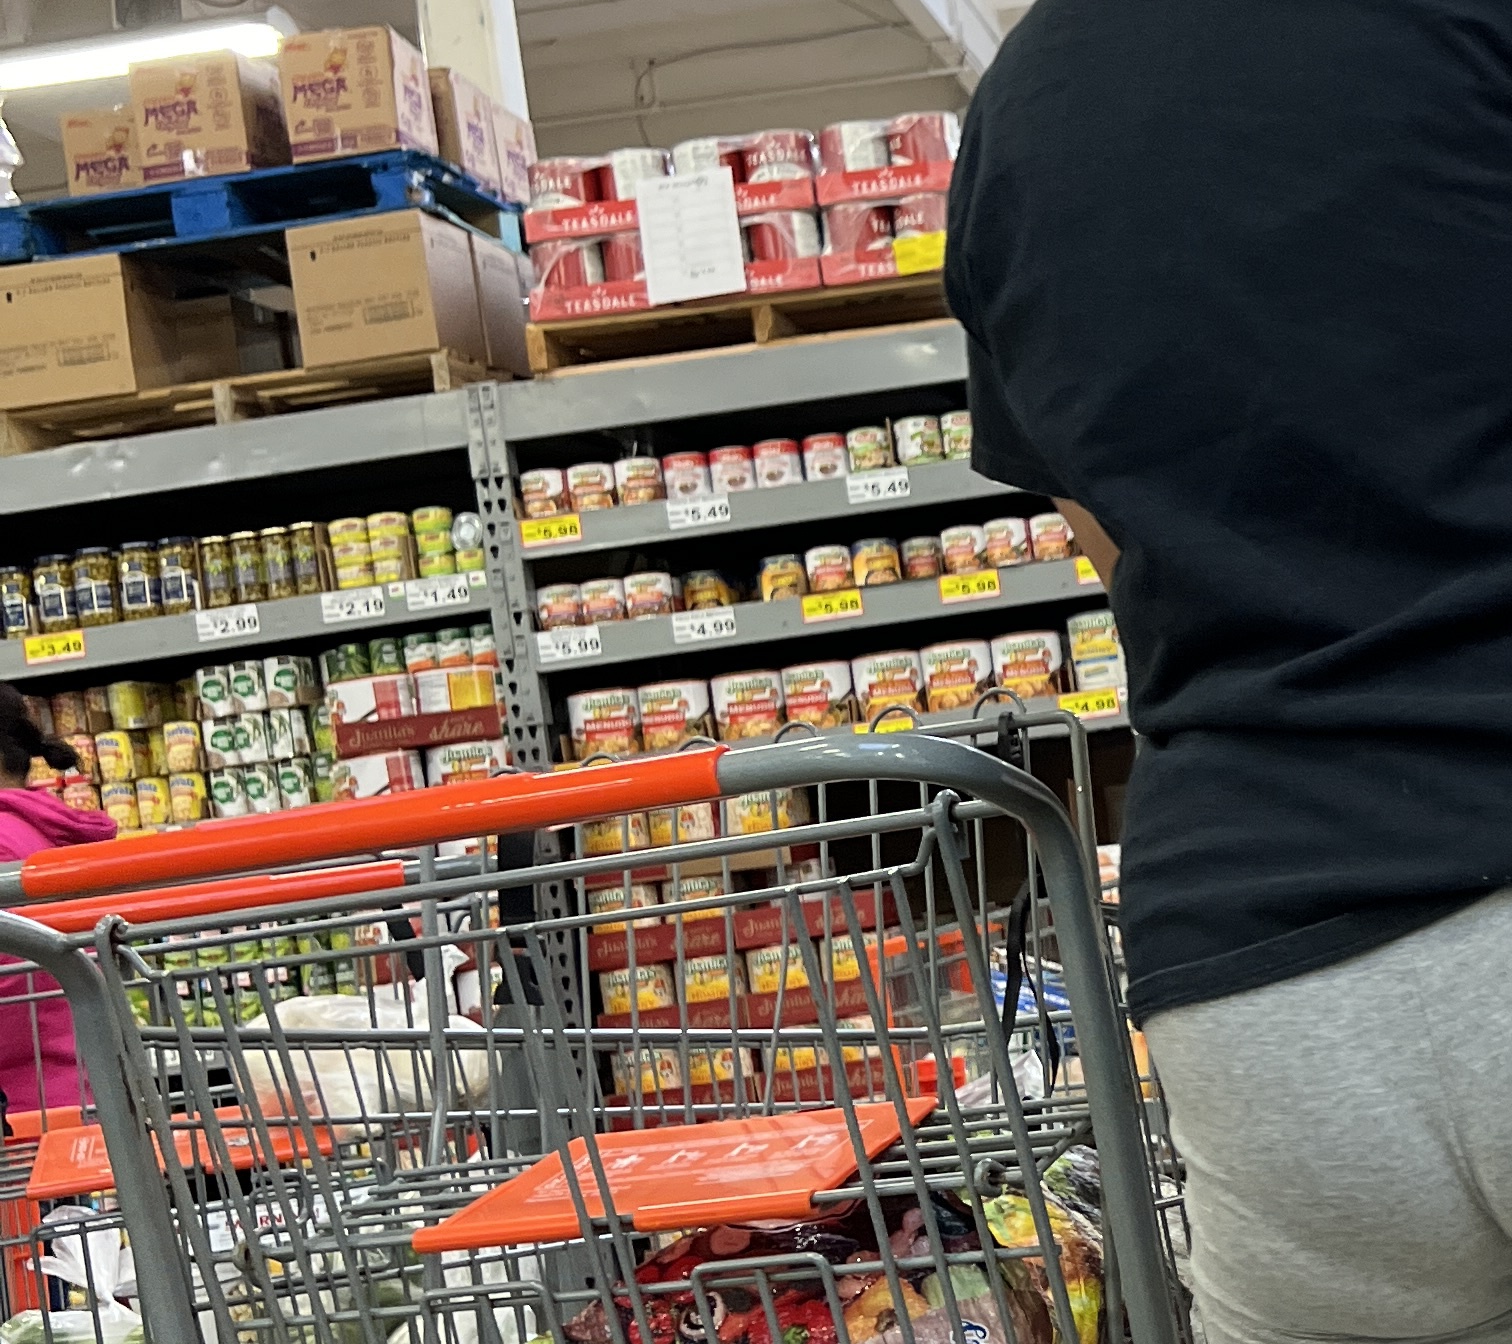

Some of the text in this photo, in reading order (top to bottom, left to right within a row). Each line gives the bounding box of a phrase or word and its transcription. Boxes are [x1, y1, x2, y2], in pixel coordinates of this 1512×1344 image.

[293, 77, 348, 104] MEGA
[144, 101, 198, 127] MEGA
[75, 156, 130, 182] MEGA
[852, 174, 921, 195] TEASDALE
[562, 210, 633, 232] TEASDALE
[859, 261, 894, 277] TEAS
[750, 276, 783, 289] DALE
[565, 295, 635, 315] TEASDALE
